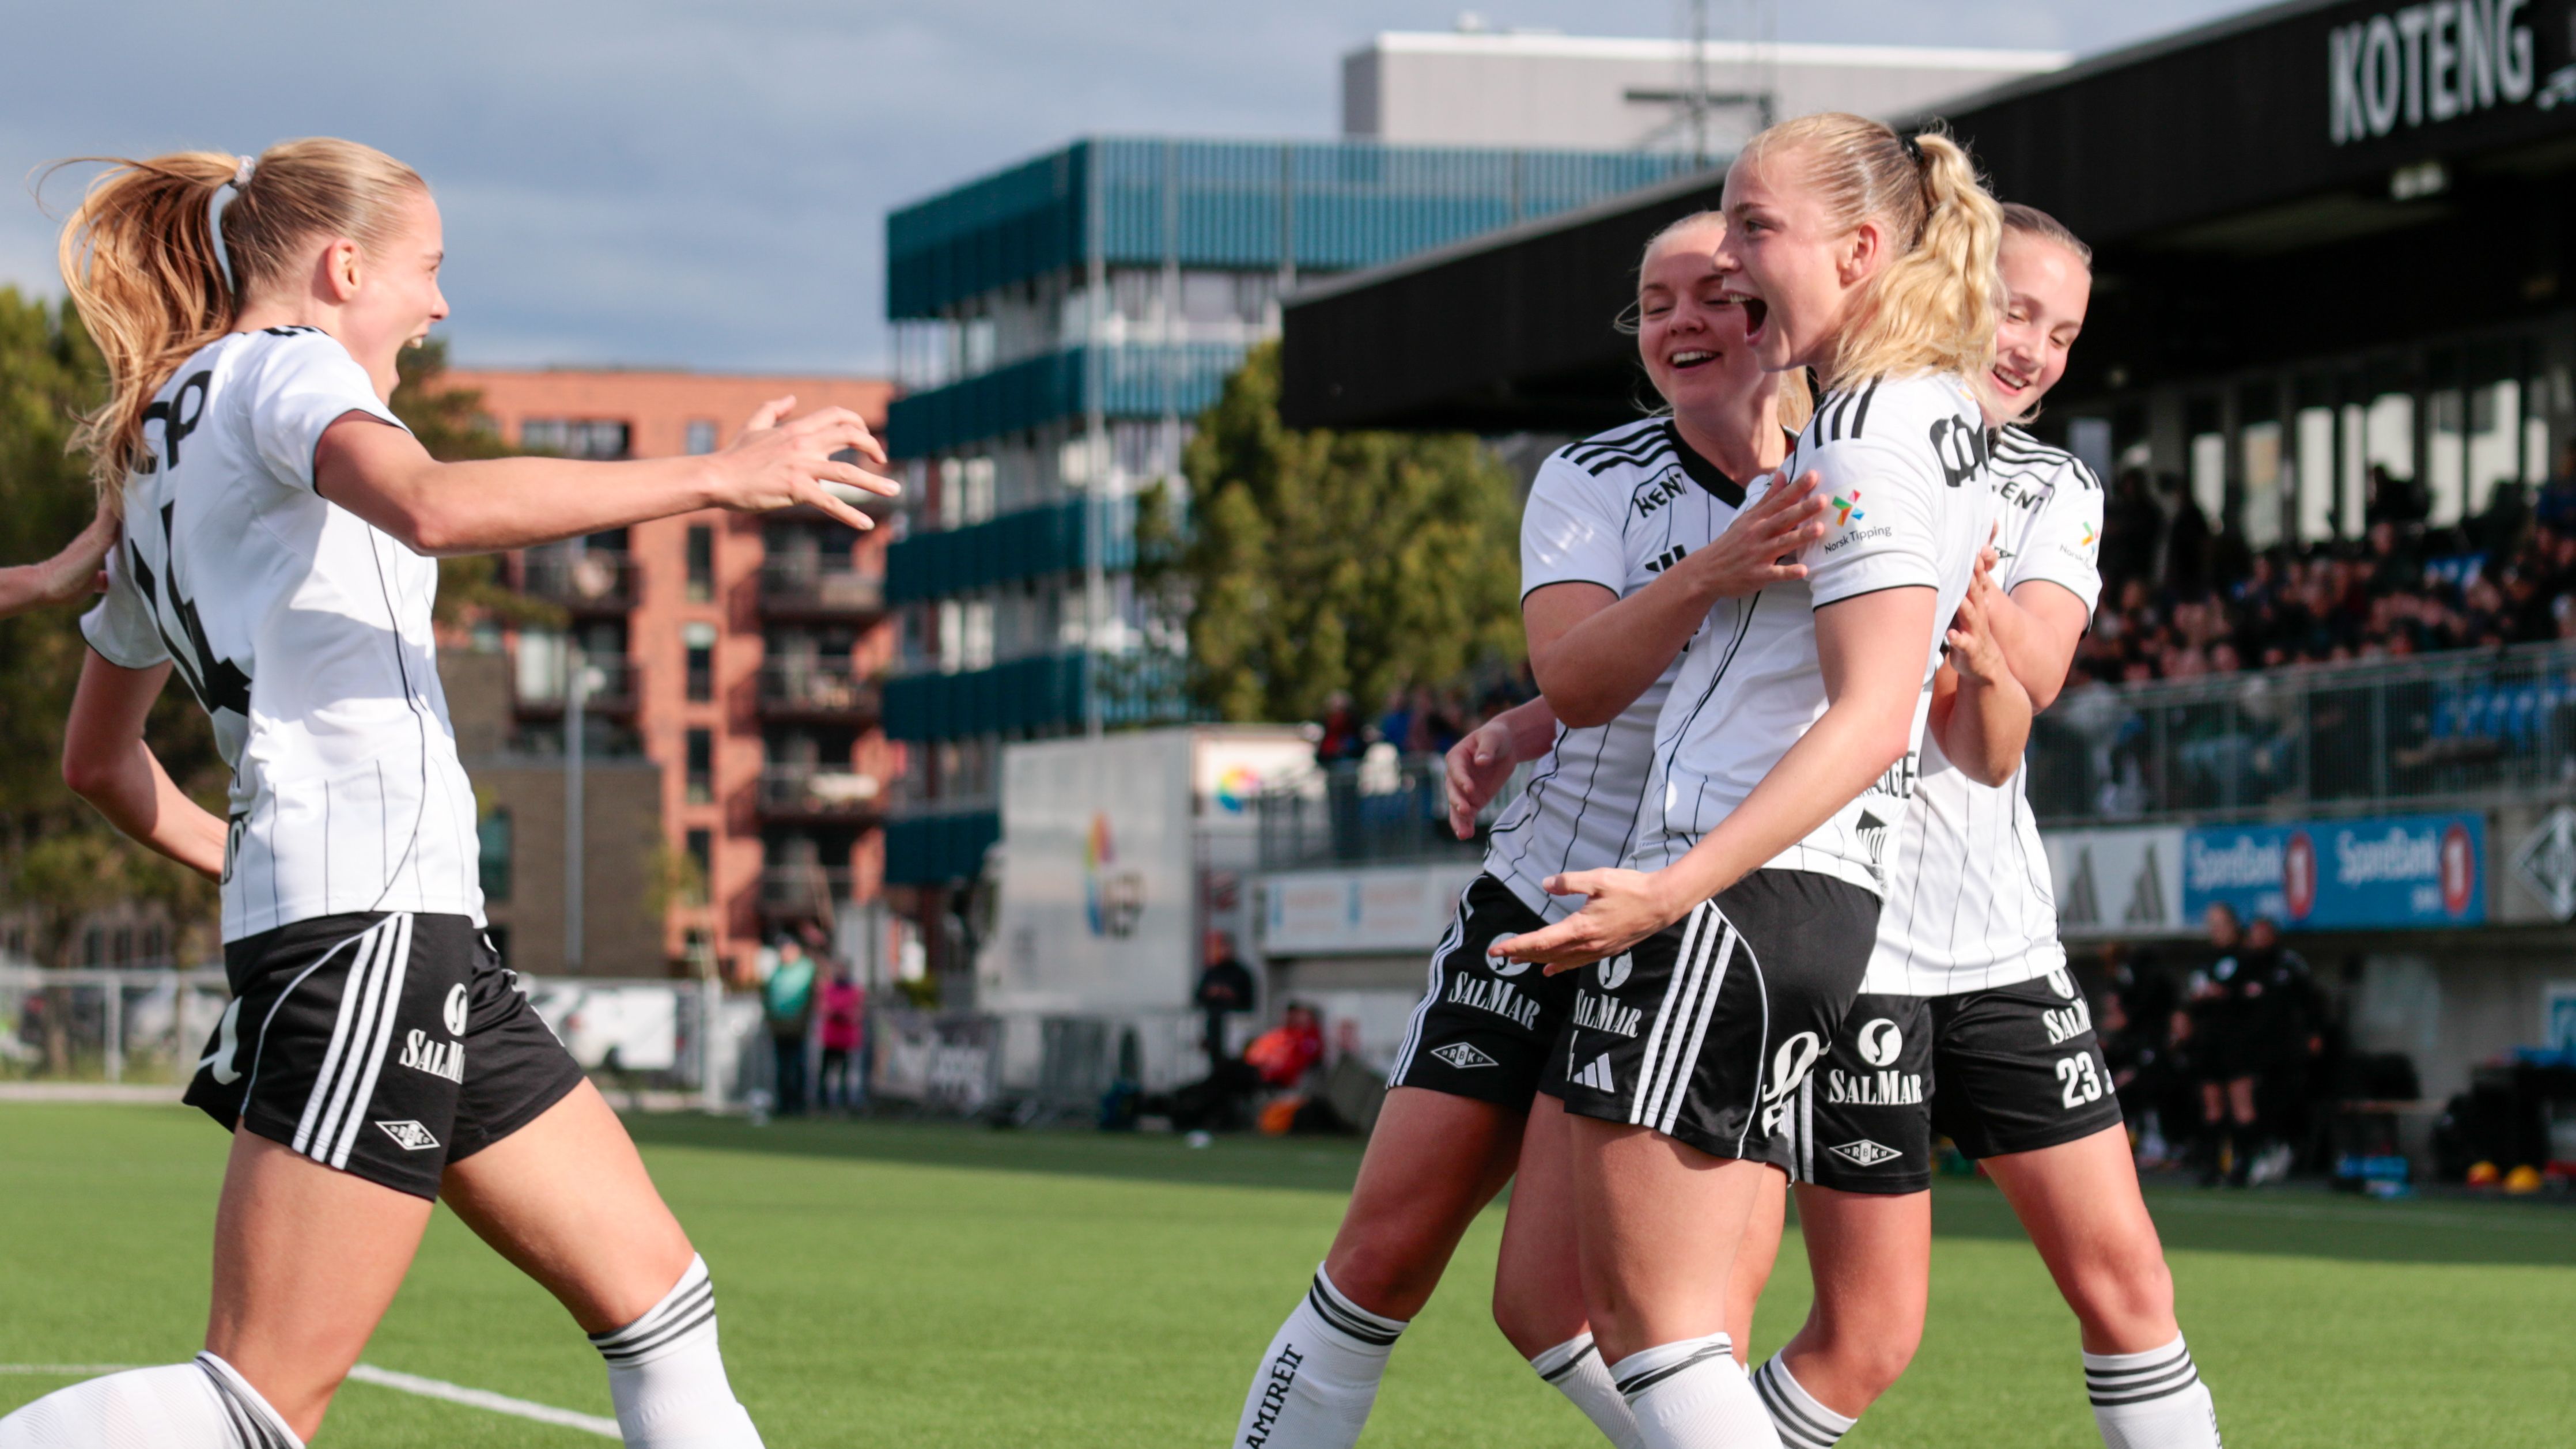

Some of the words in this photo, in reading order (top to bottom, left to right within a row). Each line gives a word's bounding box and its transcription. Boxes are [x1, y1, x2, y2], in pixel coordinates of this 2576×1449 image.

[2329, 0, 2533, 146] KOTENG
[1992, 481, 2044, 514] ENT
[1824, 535, 1849, 554] Norsk
[1849, 526, 1892, 542] Tipping
[1448, 1048, 1476, 1063] RBK
[2056, 1051, 2102, 1109] 23
[1852, 1146, 1879, 1159] RBK
